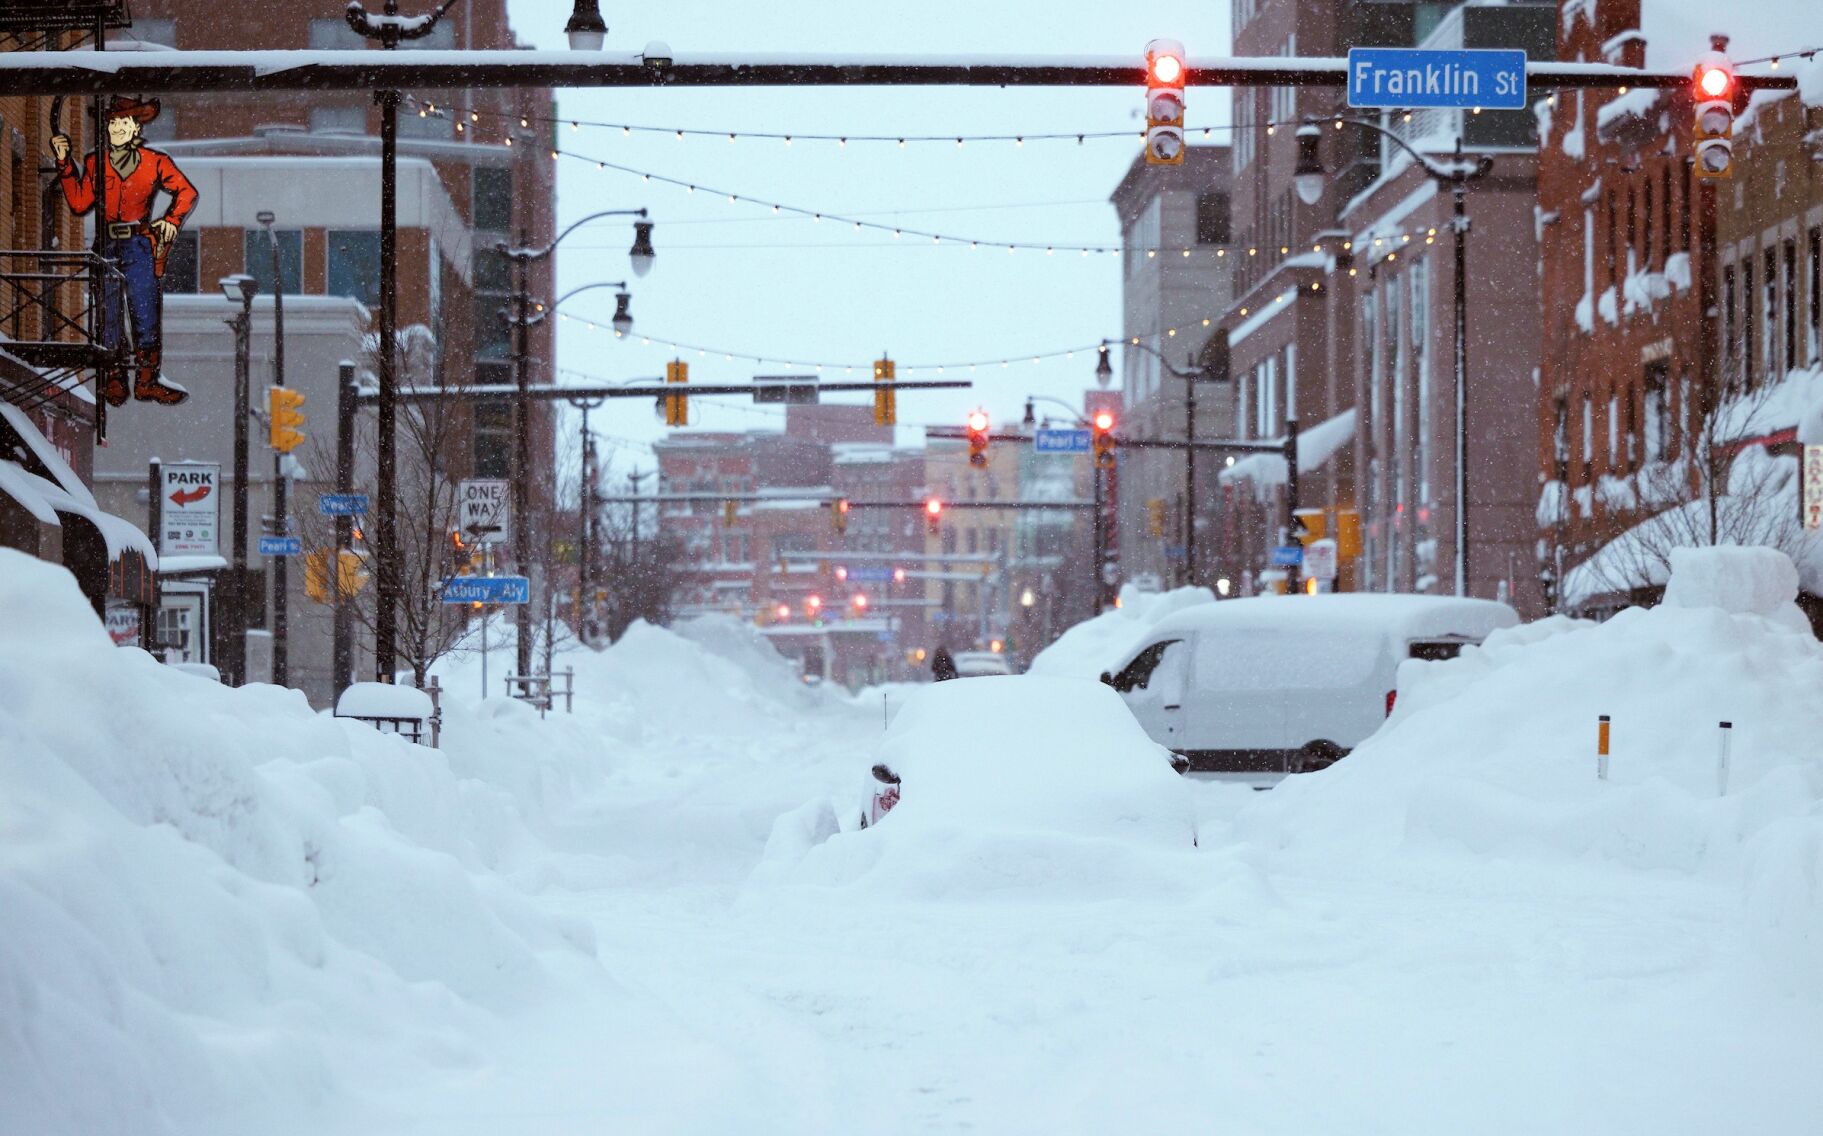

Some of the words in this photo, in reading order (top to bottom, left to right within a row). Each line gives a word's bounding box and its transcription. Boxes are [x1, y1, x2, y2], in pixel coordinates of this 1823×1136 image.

[1355, 61, 1479, 95] Franklin
[1495, 71, 1519, 95] St
[167, 472, 213, 485] PARK
[467, 485, 500, 500] ONE
[468, 503, 499, 516] WAY
[261, 540, 288, 551] Pearl
[503, 582, 525, 600] Aly
